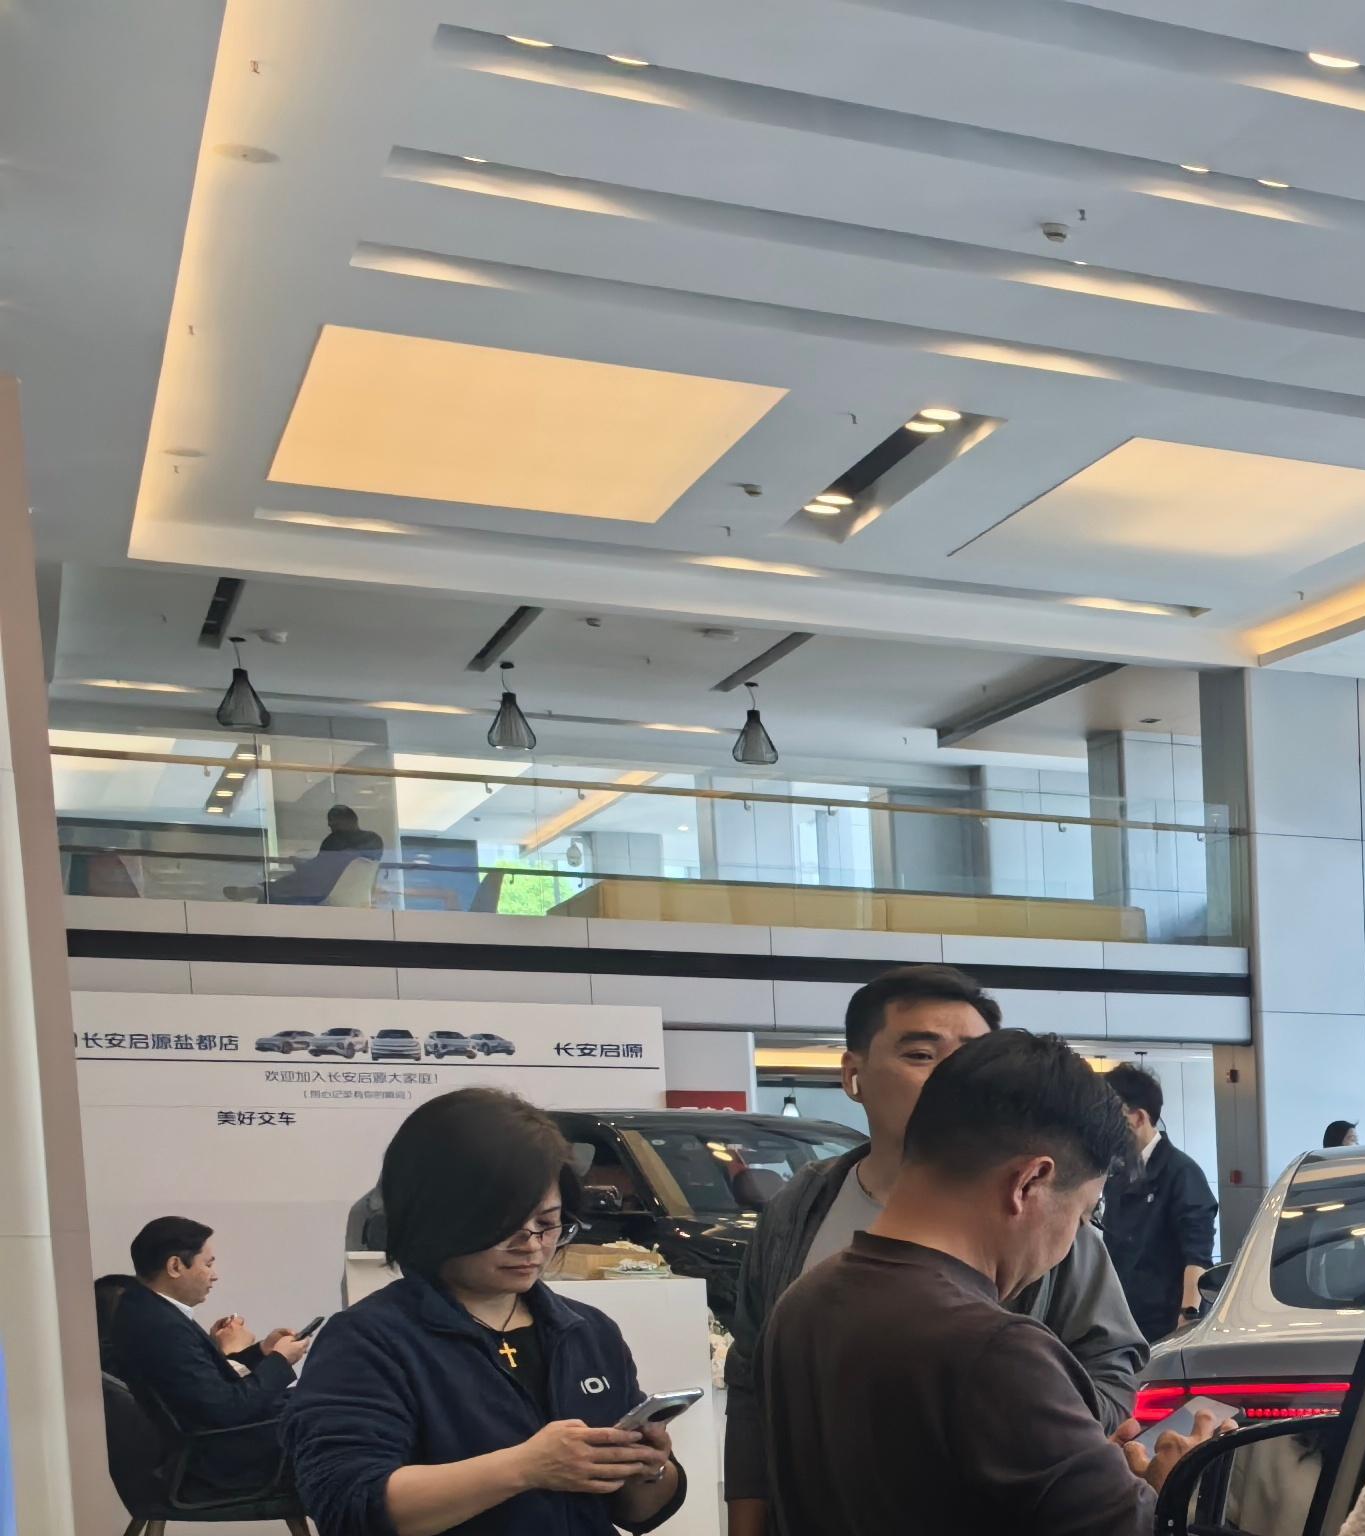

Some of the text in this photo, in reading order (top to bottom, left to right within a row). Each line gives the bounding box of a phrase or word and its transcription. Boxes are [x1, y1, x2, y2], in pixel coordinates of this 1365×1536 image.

[553, 1041, 644, 1060] 长安启源
[216, 1110, 297, 1127] 美好交车
